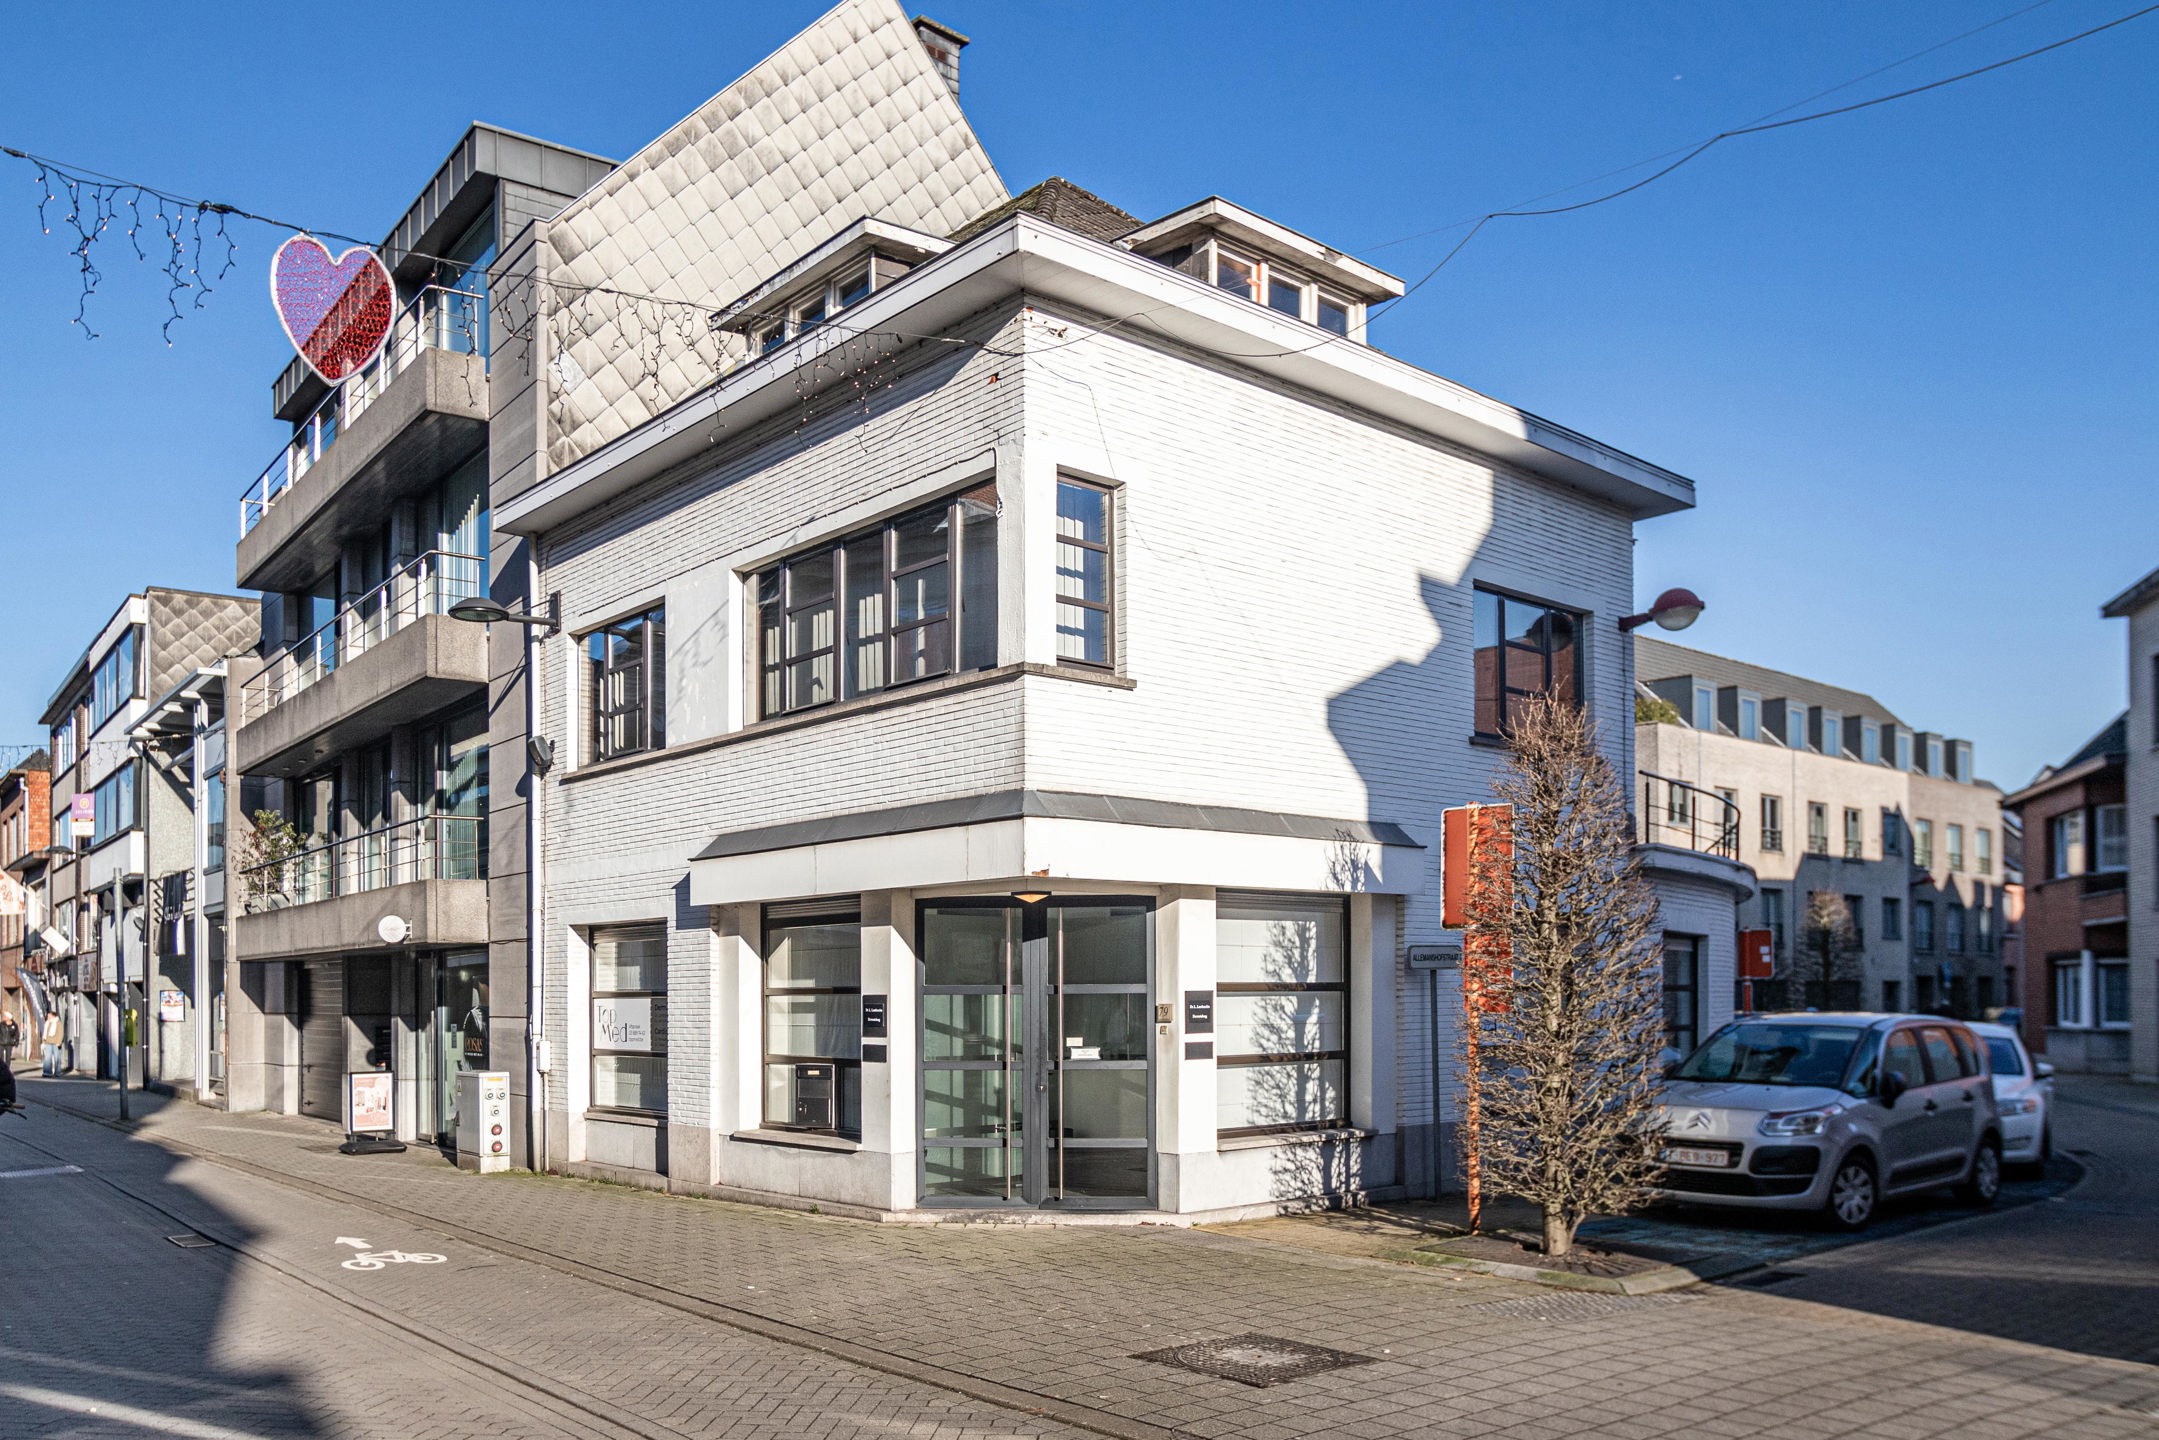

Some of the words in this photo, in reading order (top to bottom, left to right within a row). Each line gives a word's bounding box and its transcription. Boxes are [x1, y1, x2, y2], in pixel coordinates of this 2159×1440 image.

[596, 1005, 617, 1026] Top
[1159, 1007, 1168, 1016] 79
[601, 1023, 628, 1042] Med
